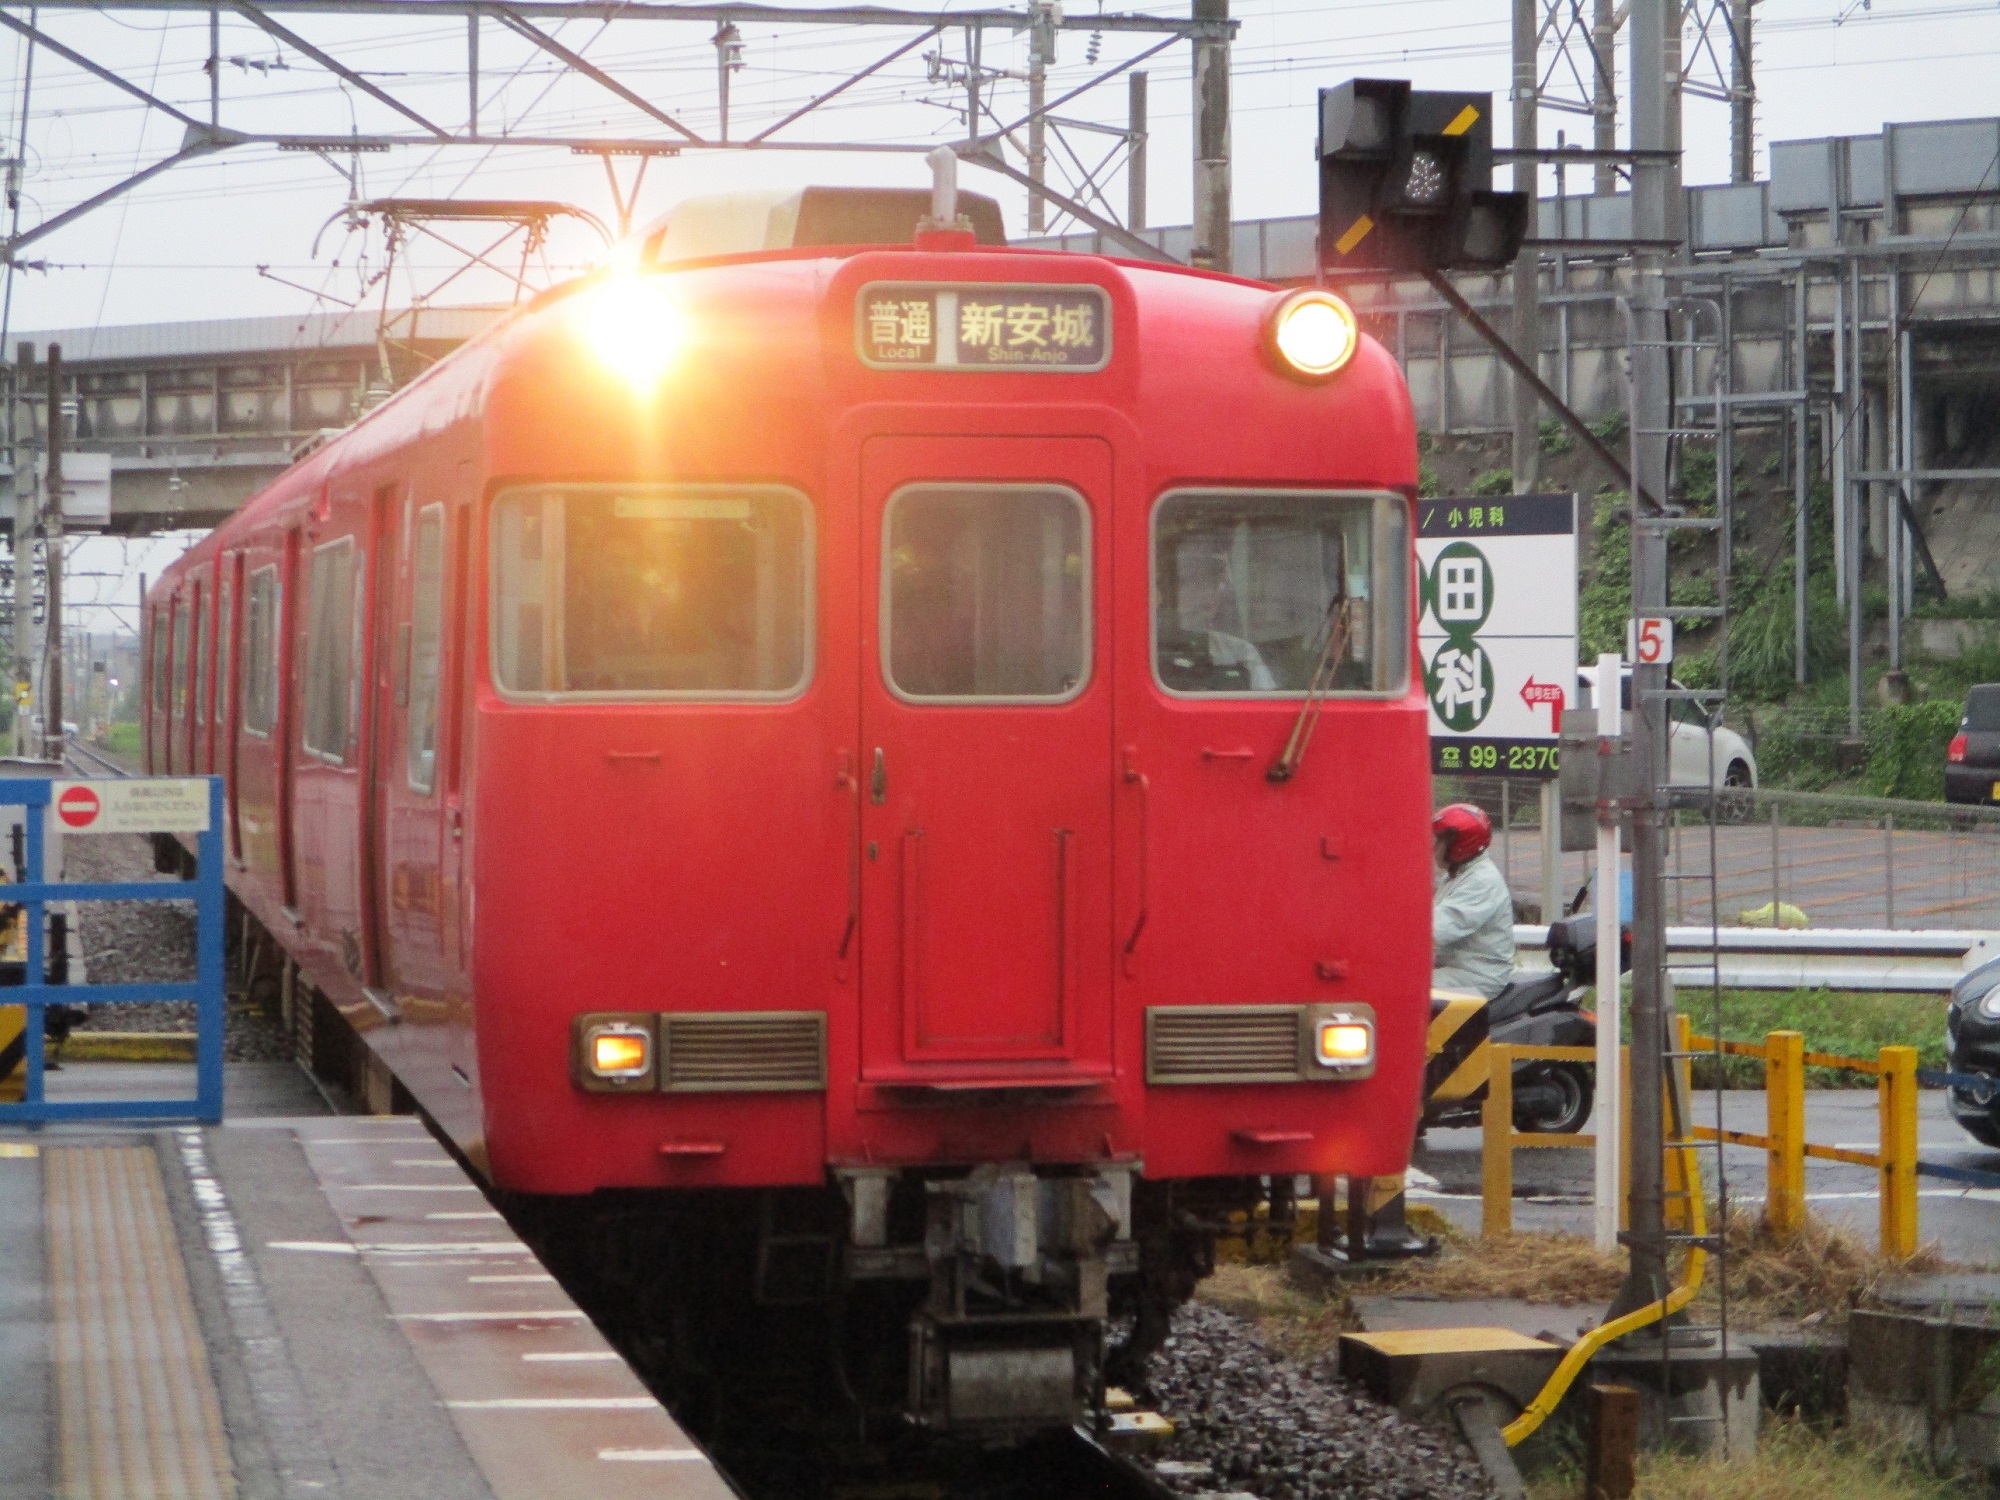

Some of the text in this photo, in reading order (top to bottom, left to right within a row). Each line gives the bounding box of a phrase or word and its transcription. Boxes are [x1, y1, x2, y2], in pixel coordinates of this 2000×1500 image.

[869, 301, 1094, 347] 普通 新安城
[878, 346, 921, 359] Local
[1448, 506, 1504, 528] 小児科
[1638, 620, 1661, 662] 5
[1436, 648, 1486, 720] 科
